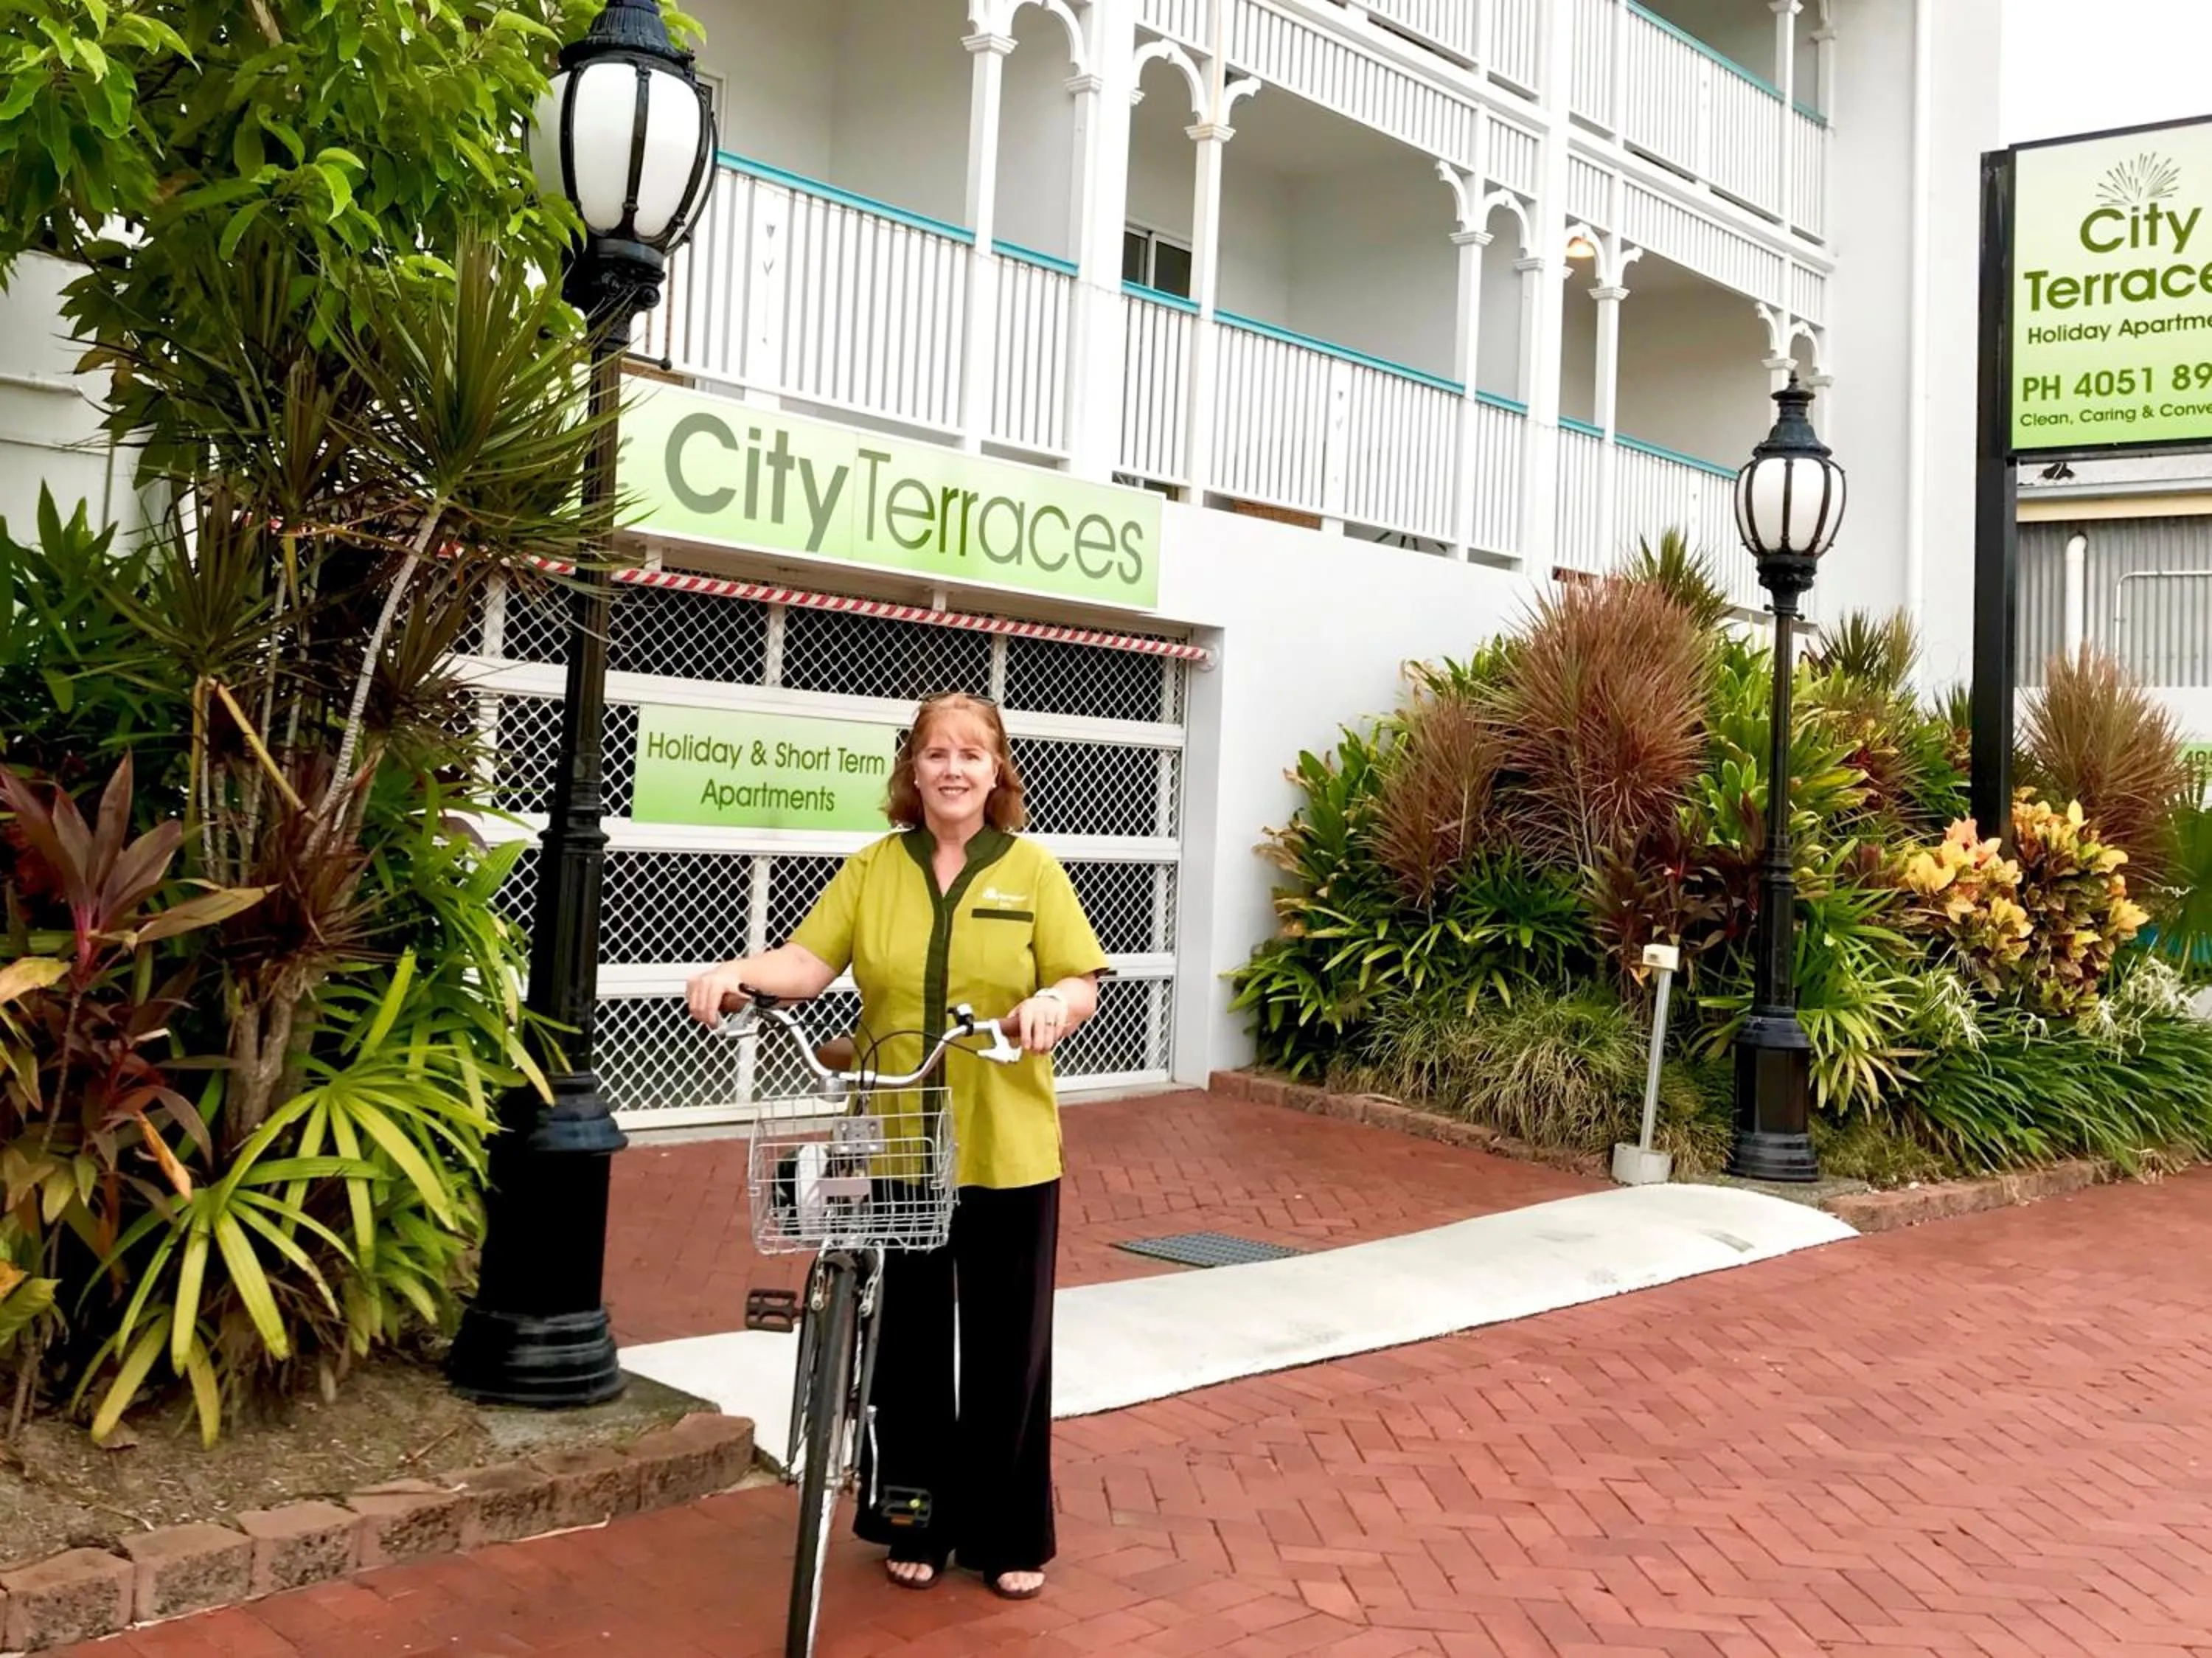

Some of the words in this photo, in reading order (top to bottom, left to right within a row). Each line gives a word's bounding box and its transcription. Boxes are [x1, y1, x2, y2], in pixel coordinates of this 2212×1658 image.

[2080, 203, 2202, 254] City
[2028, 323, 2111, 344] Holiday
[2023, 375, 2061, 401] PH
[2073, 367, 2152, 397] 4051
[2020, 413, 2073, 426] Clean,
[2079, 408, 2136, 423] Caring
[2142, 404, 2154, 419] &
[647, 732, 742, 769] Holiday
[751, 740, 767, 766] &
[774, 742, 830, 772] Short
[838, 747, 885, 774] Term
[700, 778, 835, 811] Apartments
